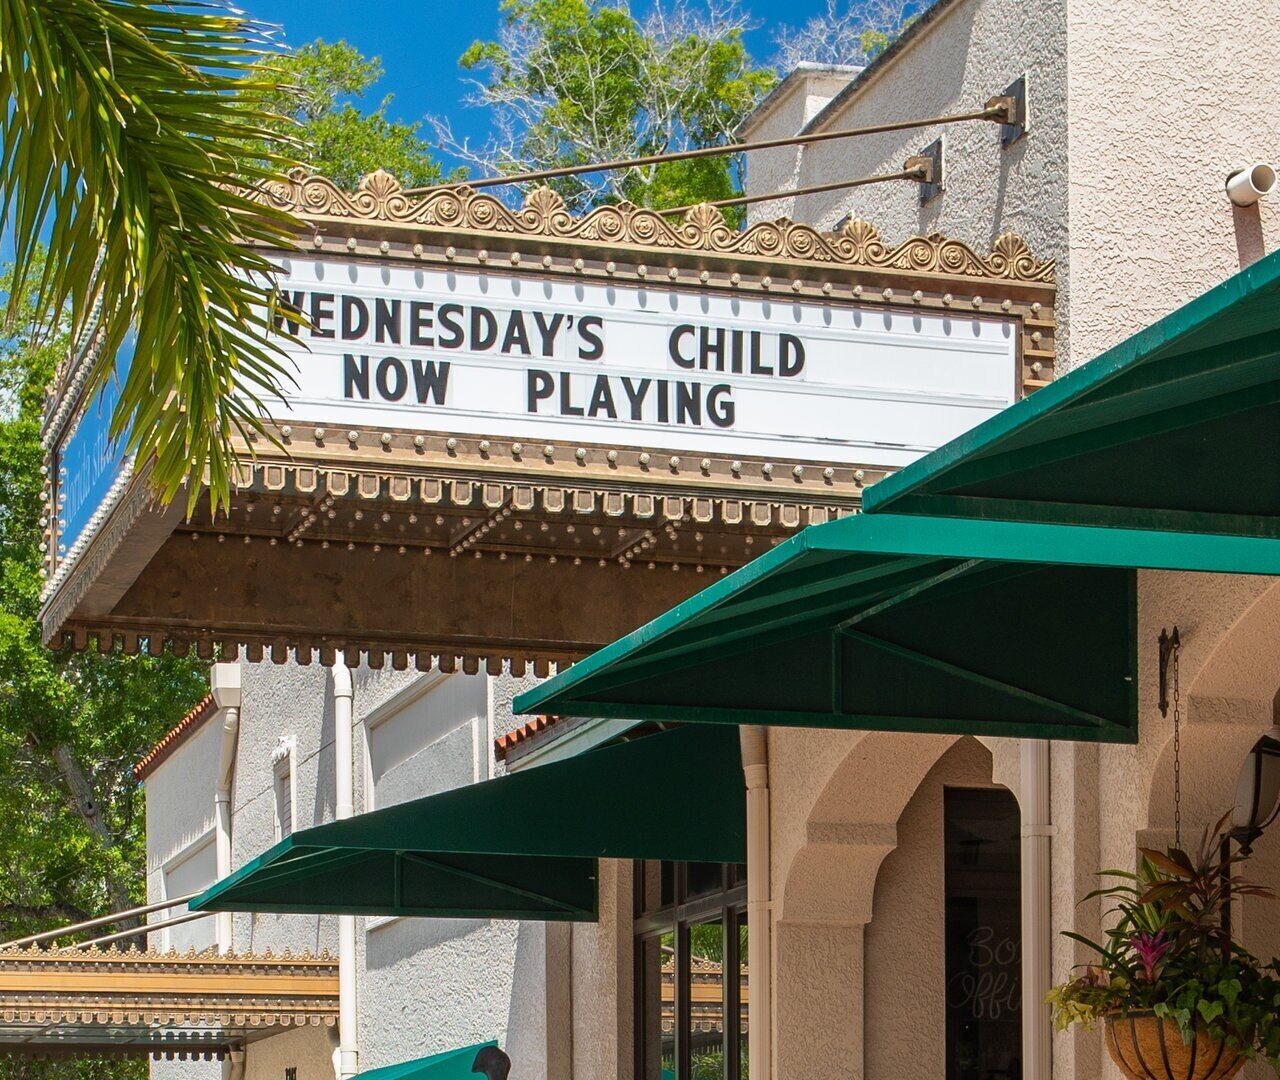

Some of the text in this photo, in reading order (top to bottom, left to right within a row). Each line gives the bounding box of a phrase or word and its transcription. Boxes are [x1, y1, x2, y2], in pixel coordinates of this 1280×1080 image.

[266, 288, 807, 379] WEDNESDAY'S CHILD
[342, 353, 737, 428] NOW PLAYING
